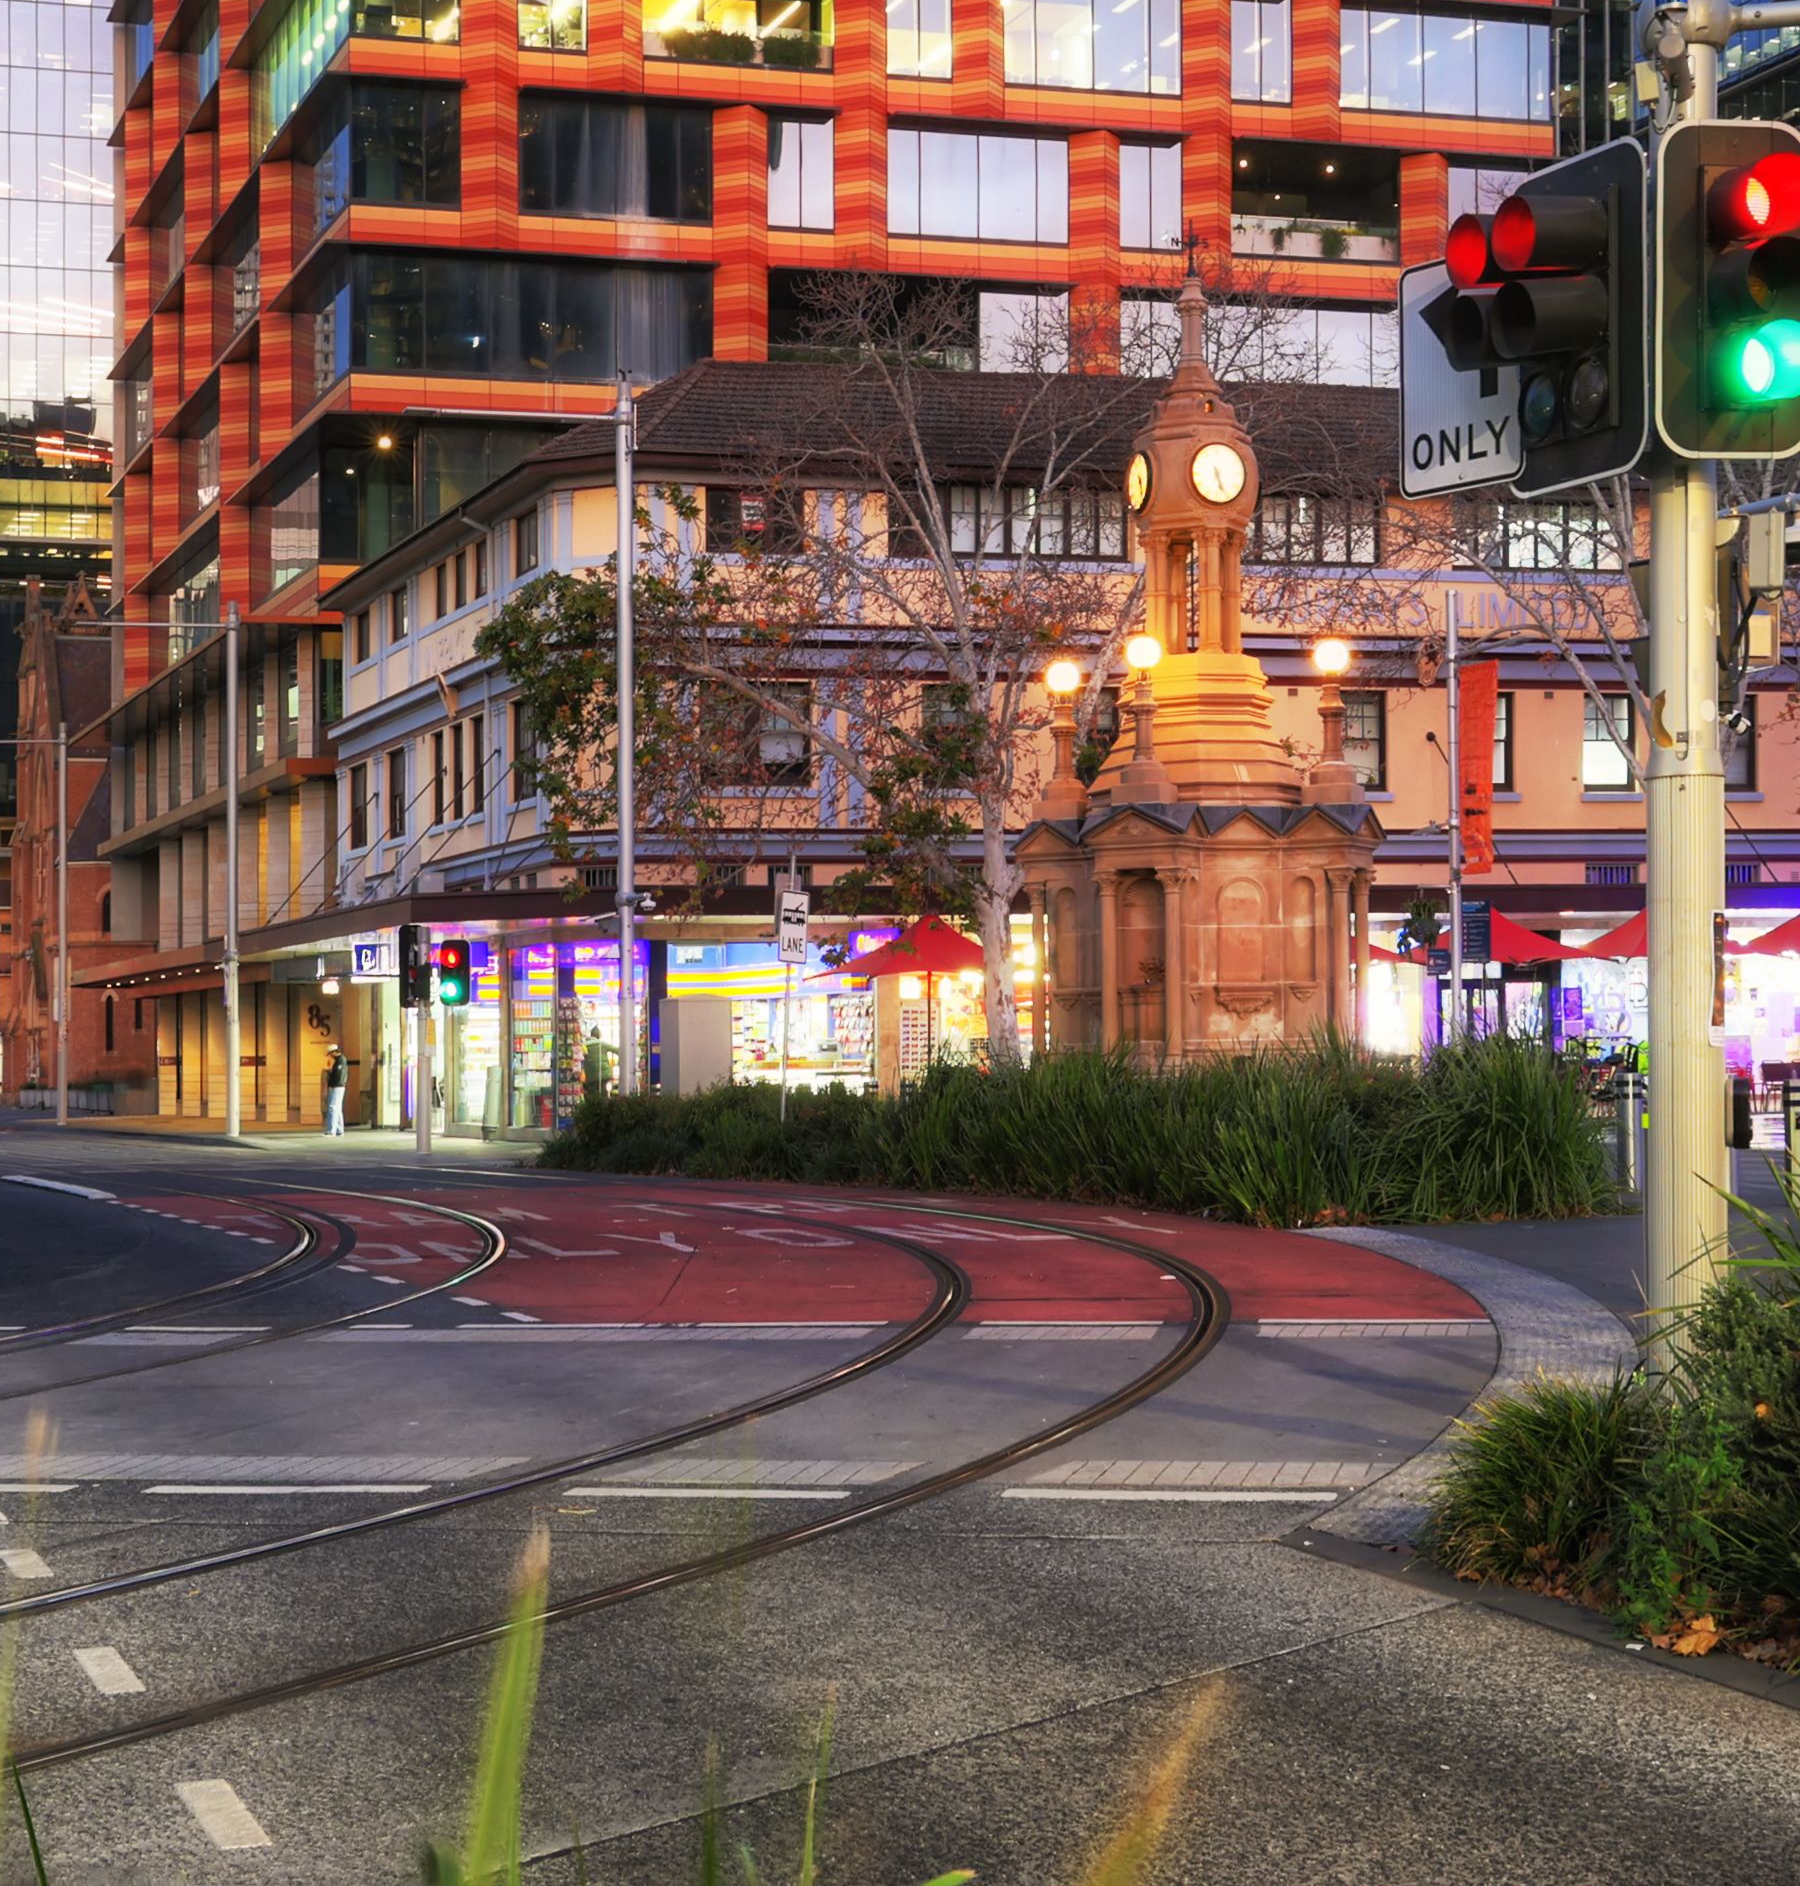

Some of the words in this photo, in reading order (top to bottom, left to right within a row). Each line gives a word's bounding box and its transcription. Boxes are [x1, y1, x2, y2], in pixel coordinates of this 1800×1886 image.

[1412, 415, 1511, 471] ONLY
[782, 936, 804, 954] LANE
[307, 1004, 331, 1037] 85
[331, 1231, 699, 1265] ONLY
[734, 1216, 1179, 1247] ONLY
